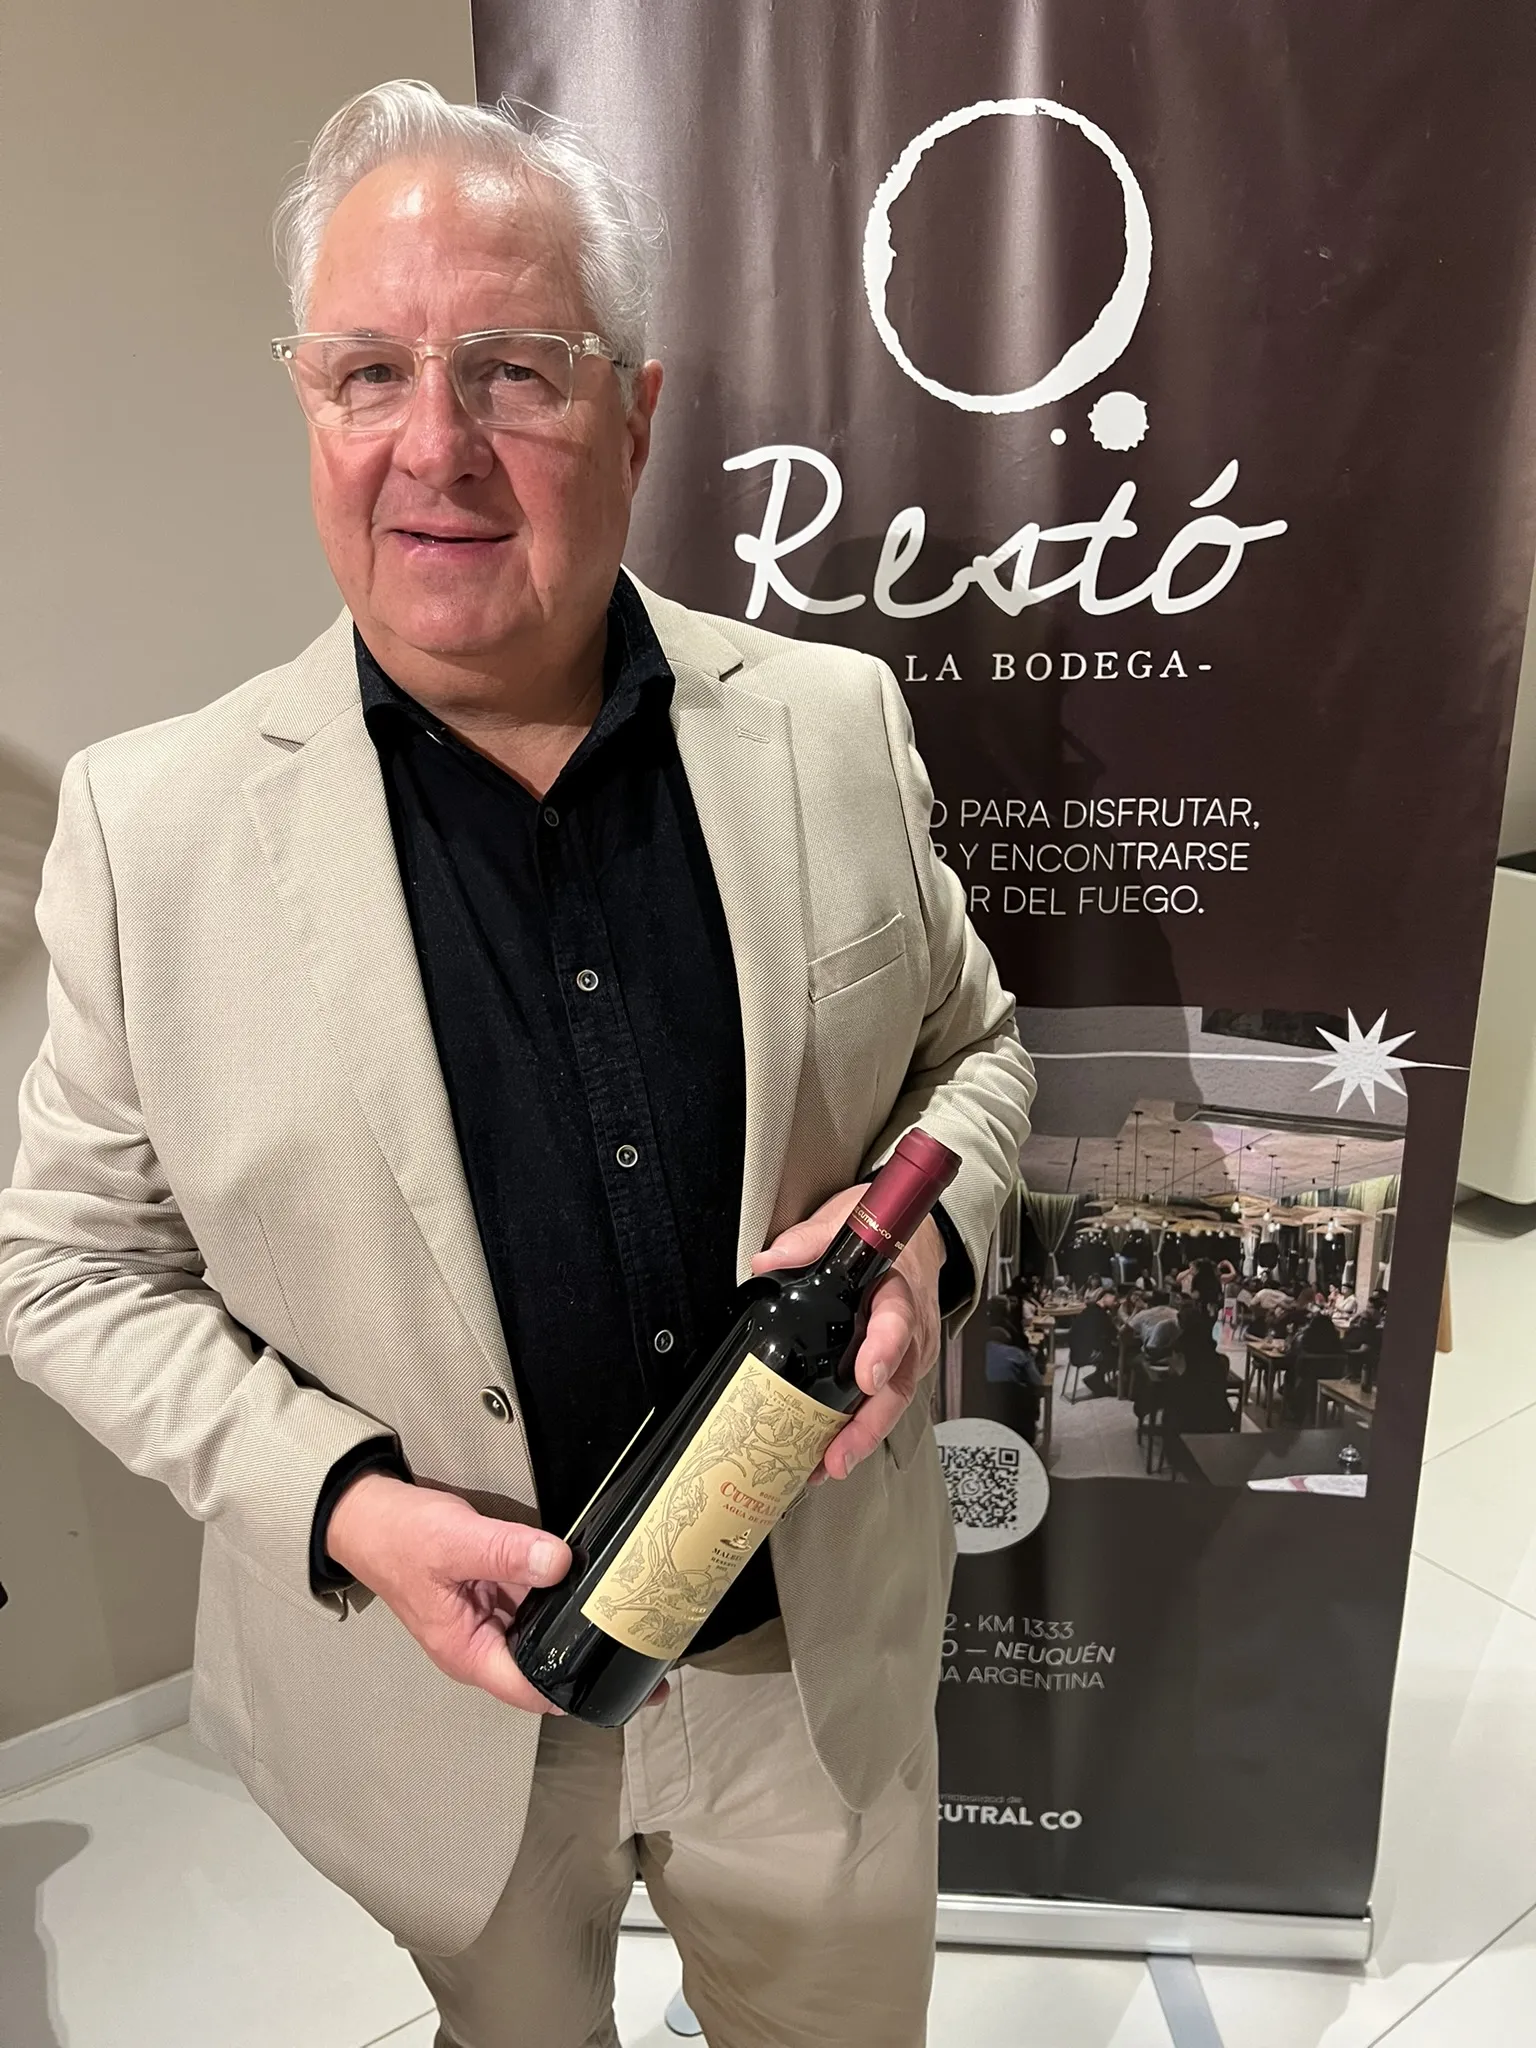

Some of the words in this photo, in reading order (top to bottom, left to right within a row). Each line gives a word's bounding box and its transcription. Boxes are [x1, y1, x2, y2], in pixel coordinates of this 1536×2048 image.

[722, 445, 1288, 619] Restó
[905, 653, 962, 681] LA
[960, 799, 1050, 829] PARA
[1064, 798, 1260, 830] DISFRUTAR,
[959, 843, 979, 870] Y
[990, 842, 1250, 872] ENCONTRARSE
[1004, 886, 1067, 915] DEL
[1079, 884, 1205, 915] FUEGO.
[978, 1614, 1014, 1633] KM
[1022, 1616, 1075, 1640] 1333
[994, 1641, 1116, 1666] NEUQUÉN
[966, 1666, 1105, 1691] ARGENTINA
[1039, 1810, 1083, 1831] CO
